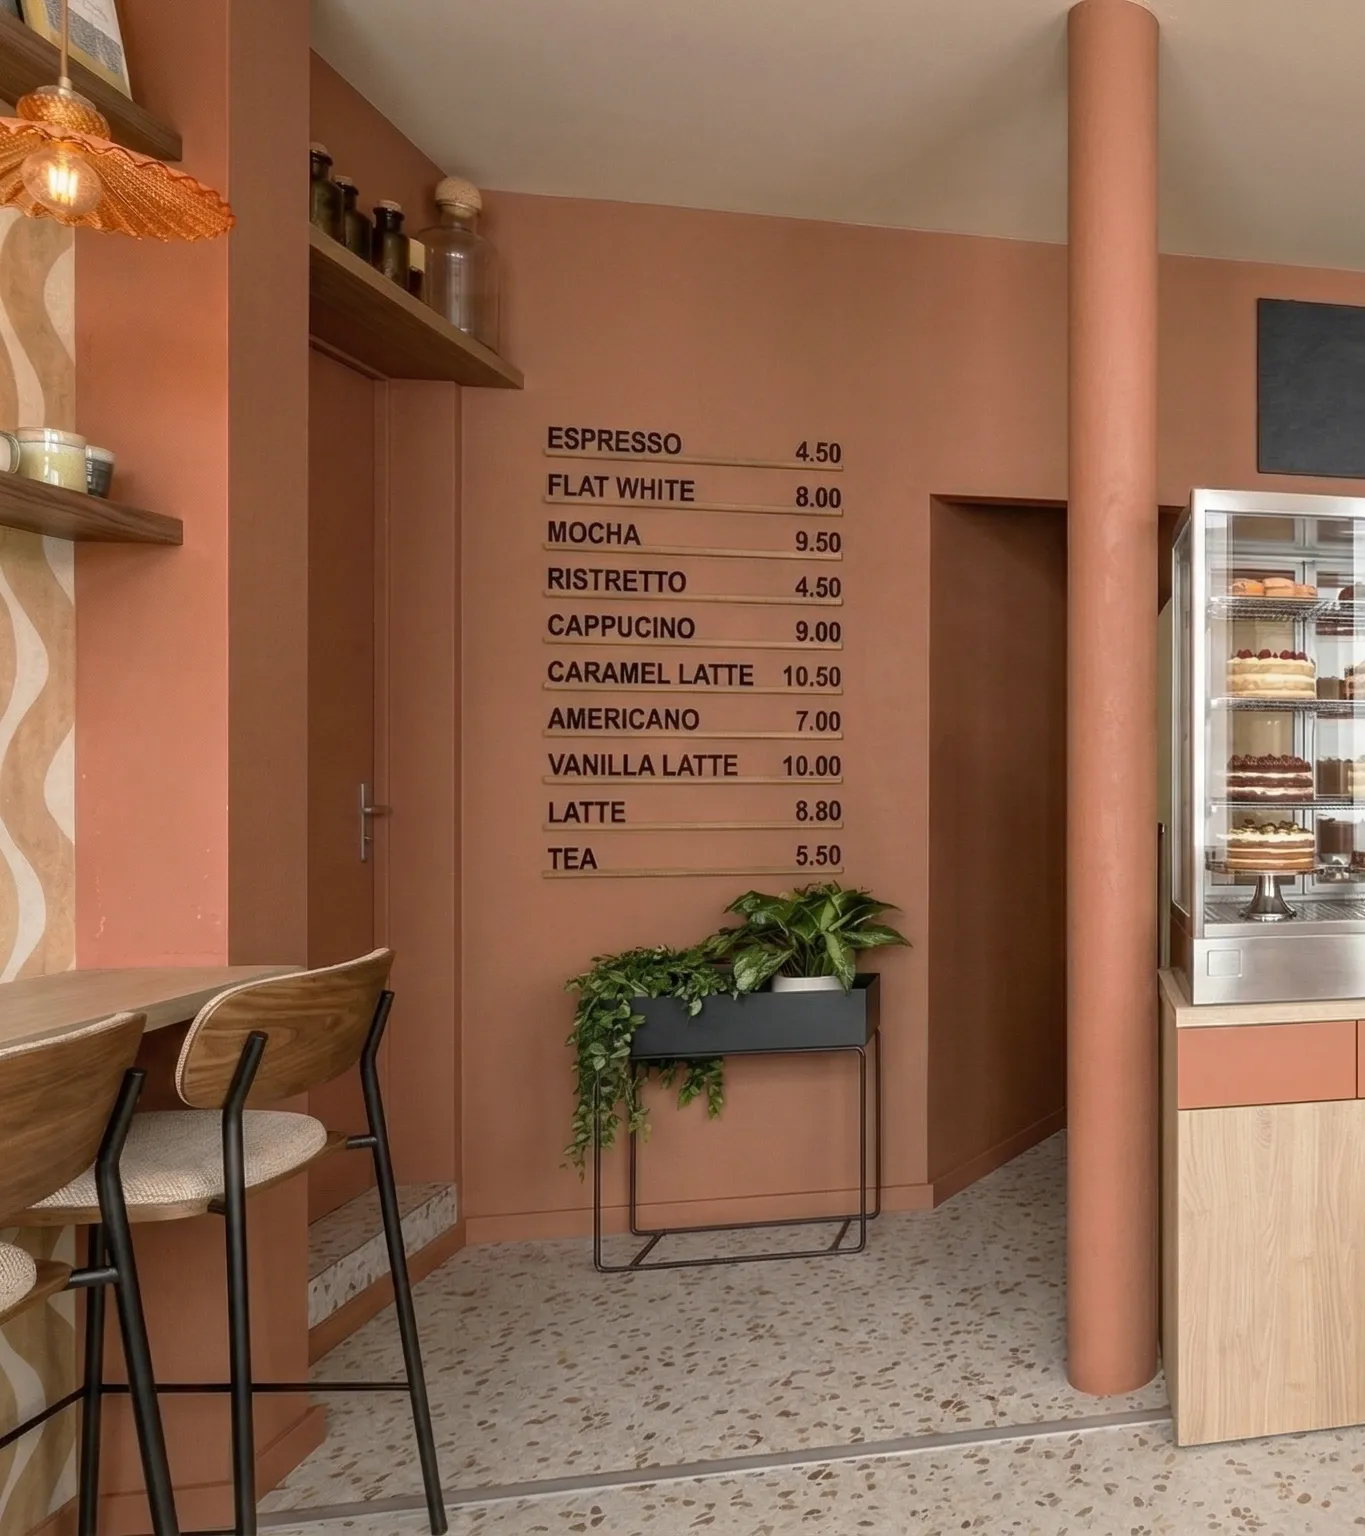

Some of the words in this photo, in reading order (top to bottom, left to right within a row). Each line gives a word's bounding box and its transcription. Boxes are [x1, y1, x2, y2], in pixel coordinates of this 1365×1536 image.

[546, 426, 682, 455] ESPRESSO
[795, 440, 842, 464] 4.50
[547, 473, 610, 498] FLAT
[615, 476, 695, 502] WHITE
[795, 485, 842, 509] 8.00
[547, 520, 642, 546] MOCHA
[795, 530, 842, 553] 9.50
[547, 567, 687, 593] RISTRETTO
[795, 576, 842, 599] 4.50
[547, 613, 696, 639] CAPPUCINO
[795, 620, 841, 643] 9.00
[547, 660, 671, 685] CARAMEL
[678, 663, 754, 687] LATTE
[783, 665, 841, 688] 10.50
[547, 707, 700, 731] AMERICANO
[795, 710, 841, 732] 7.00
[547, 753, 656, 777] VANILLA
[662, 754, 738, 777] LATTE
[782, 755, 841, 777] 10.00
[548, 801, 626, 824] LATTE
[795, 799, 842, 822] 8.80
[547, 847, 598, 871] TEA
[795, 844, 841, 867] 5.50
